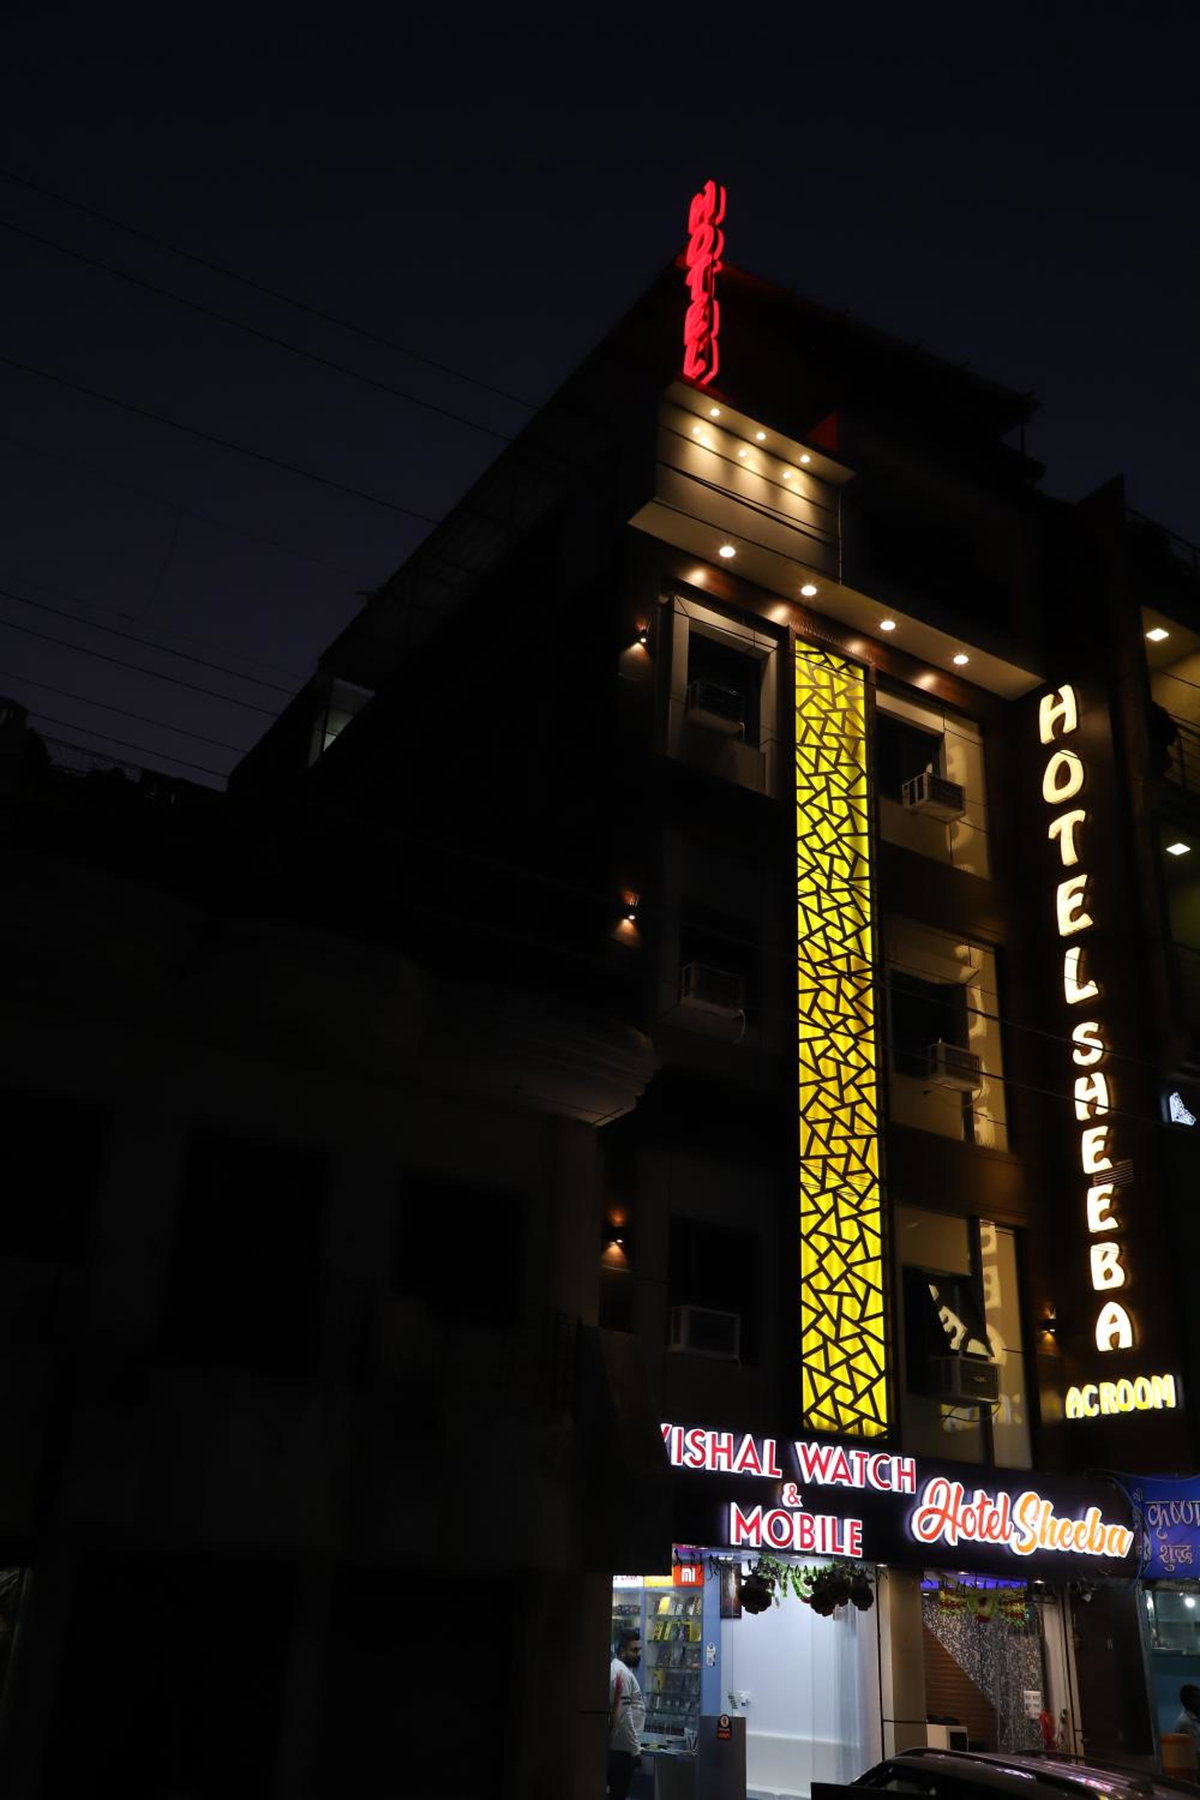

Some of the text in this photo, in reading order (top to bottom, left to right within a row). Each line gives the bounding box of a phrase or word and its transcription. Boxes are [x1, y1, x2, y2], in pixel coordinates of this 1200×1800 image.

[684, 180, 726, 385] HOTEL
[1040, 684, 1133, 1352] HOTEL SHEEBA
[782, 1483, 803, 1507] &
[795, 1442, 916, 1494] WATCH
[730, 1502, 862, 1558] MOBILE
[911, 1477, 1134, 1558] Hotel Sheeba
